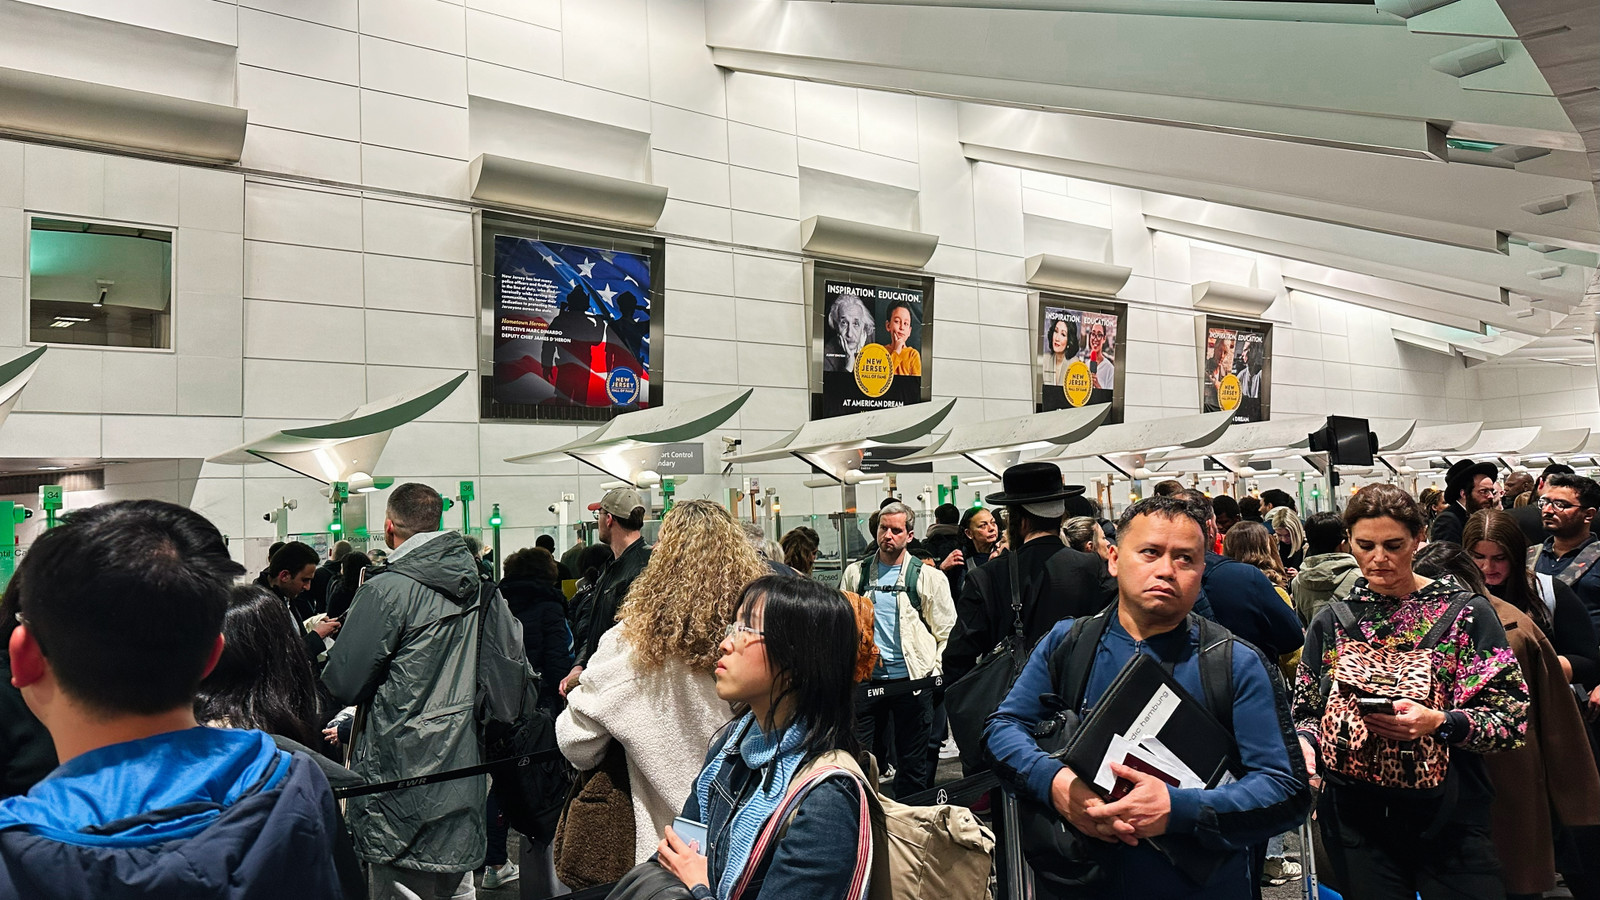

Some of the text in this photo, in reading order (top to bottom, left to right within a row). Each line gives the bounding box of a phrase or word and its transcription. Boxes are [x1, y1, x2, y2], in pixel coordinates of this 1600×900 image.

[827, 284, 921, 303] INSPIRATION. EDUCATION.
[658, 460, 675, 468] ndary
[867, 687, 885, 697] EWR
[1140, 690, 1169, 727] hamburg
[397, 777, 427, 788] EWR
